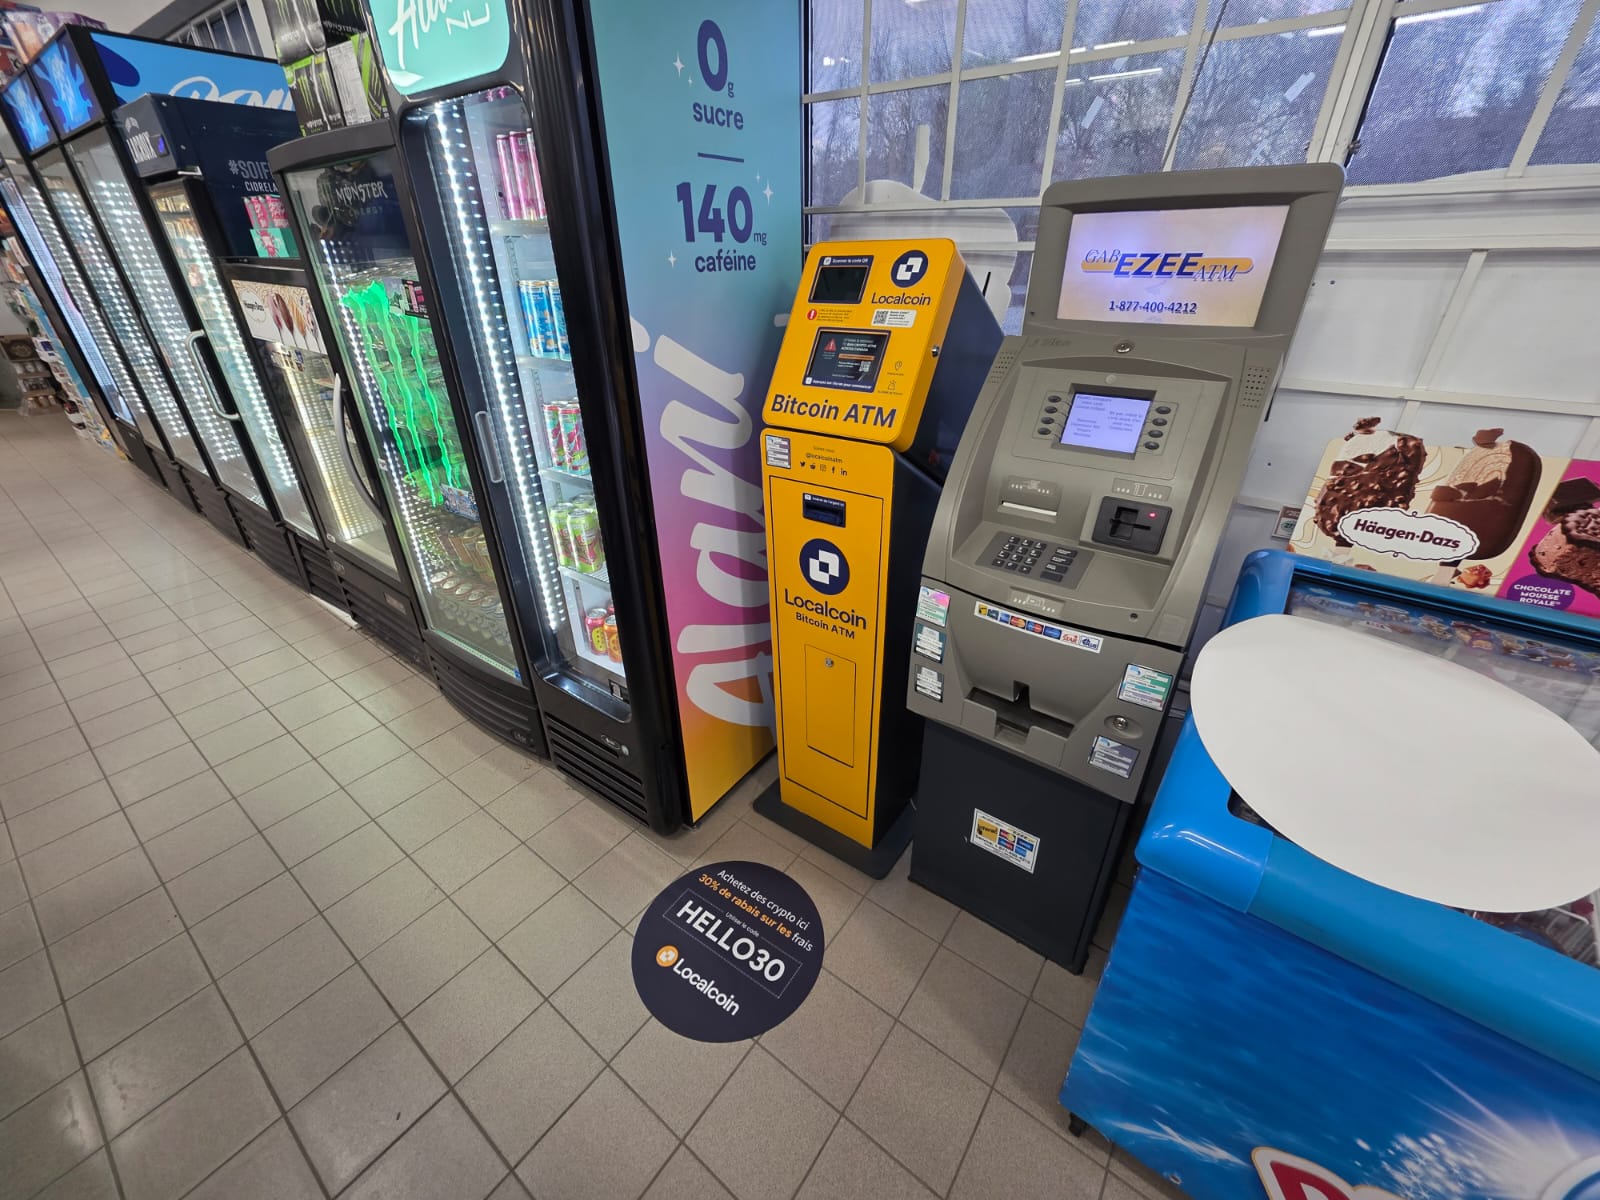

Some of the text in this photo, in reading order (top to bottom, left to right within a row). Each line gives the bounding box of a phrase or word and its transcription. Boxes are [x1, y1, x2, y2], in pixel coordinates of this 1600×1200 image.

[692, 101, 744, 130] sucre
[694, 249, 757, 273] caféine
[1084, 248, 1239, 282] GAB EZEE ATM
[871, 292, 931, 306] Localcoin
[1108, 300, 1198, 314] 1-877-400-4212
[771, 394, 897, 428] Bitcoin ATM
[1513, 584, 1572, 596] CHOCOLATE
[1520, 591, 1560, 601] MOUSSE
[784, 588, 867, 630] Localcoin
[795, 612, 855, 639] Bitcoin ATM
[698, 873, 813, 952] 30% de rabais sur les frais
[717, 869, 810, 931] Achetez des crypto ici
[676, 899, 786, 983] HELLO30
[672, 957, 740, 1016] Localcoin
